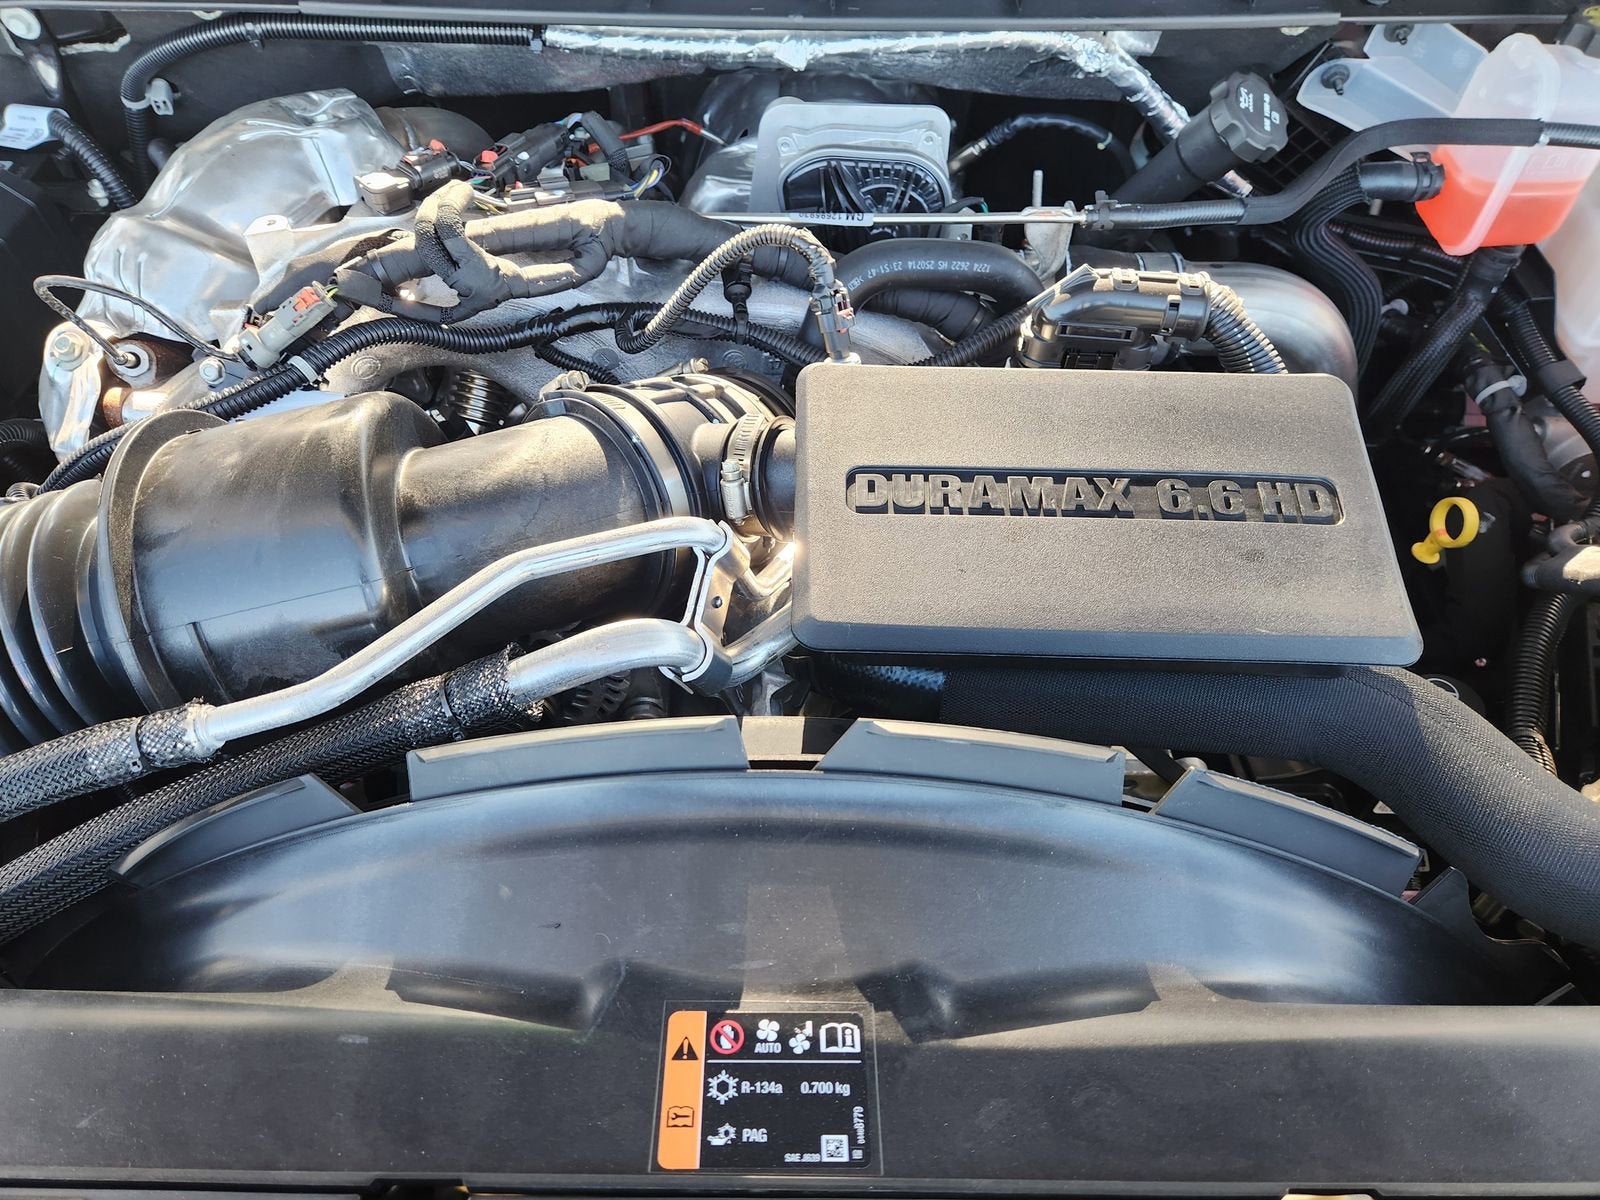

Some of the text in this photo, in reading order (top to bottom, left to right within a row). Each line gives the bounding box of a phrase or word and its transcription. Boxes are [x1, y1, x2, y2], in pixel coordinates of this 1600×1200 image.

[846, 212, 864, 221] GM
[937, 260, 948, 270] HS
[854, 473, 1335, 520] DURAMAX 6.6 HD
[754, 1042, 782, 1054] AUTO
[740, 1081, 851, 1097] R-134a 0.700 kg
[741, 1128, 768, 1143] PAG
